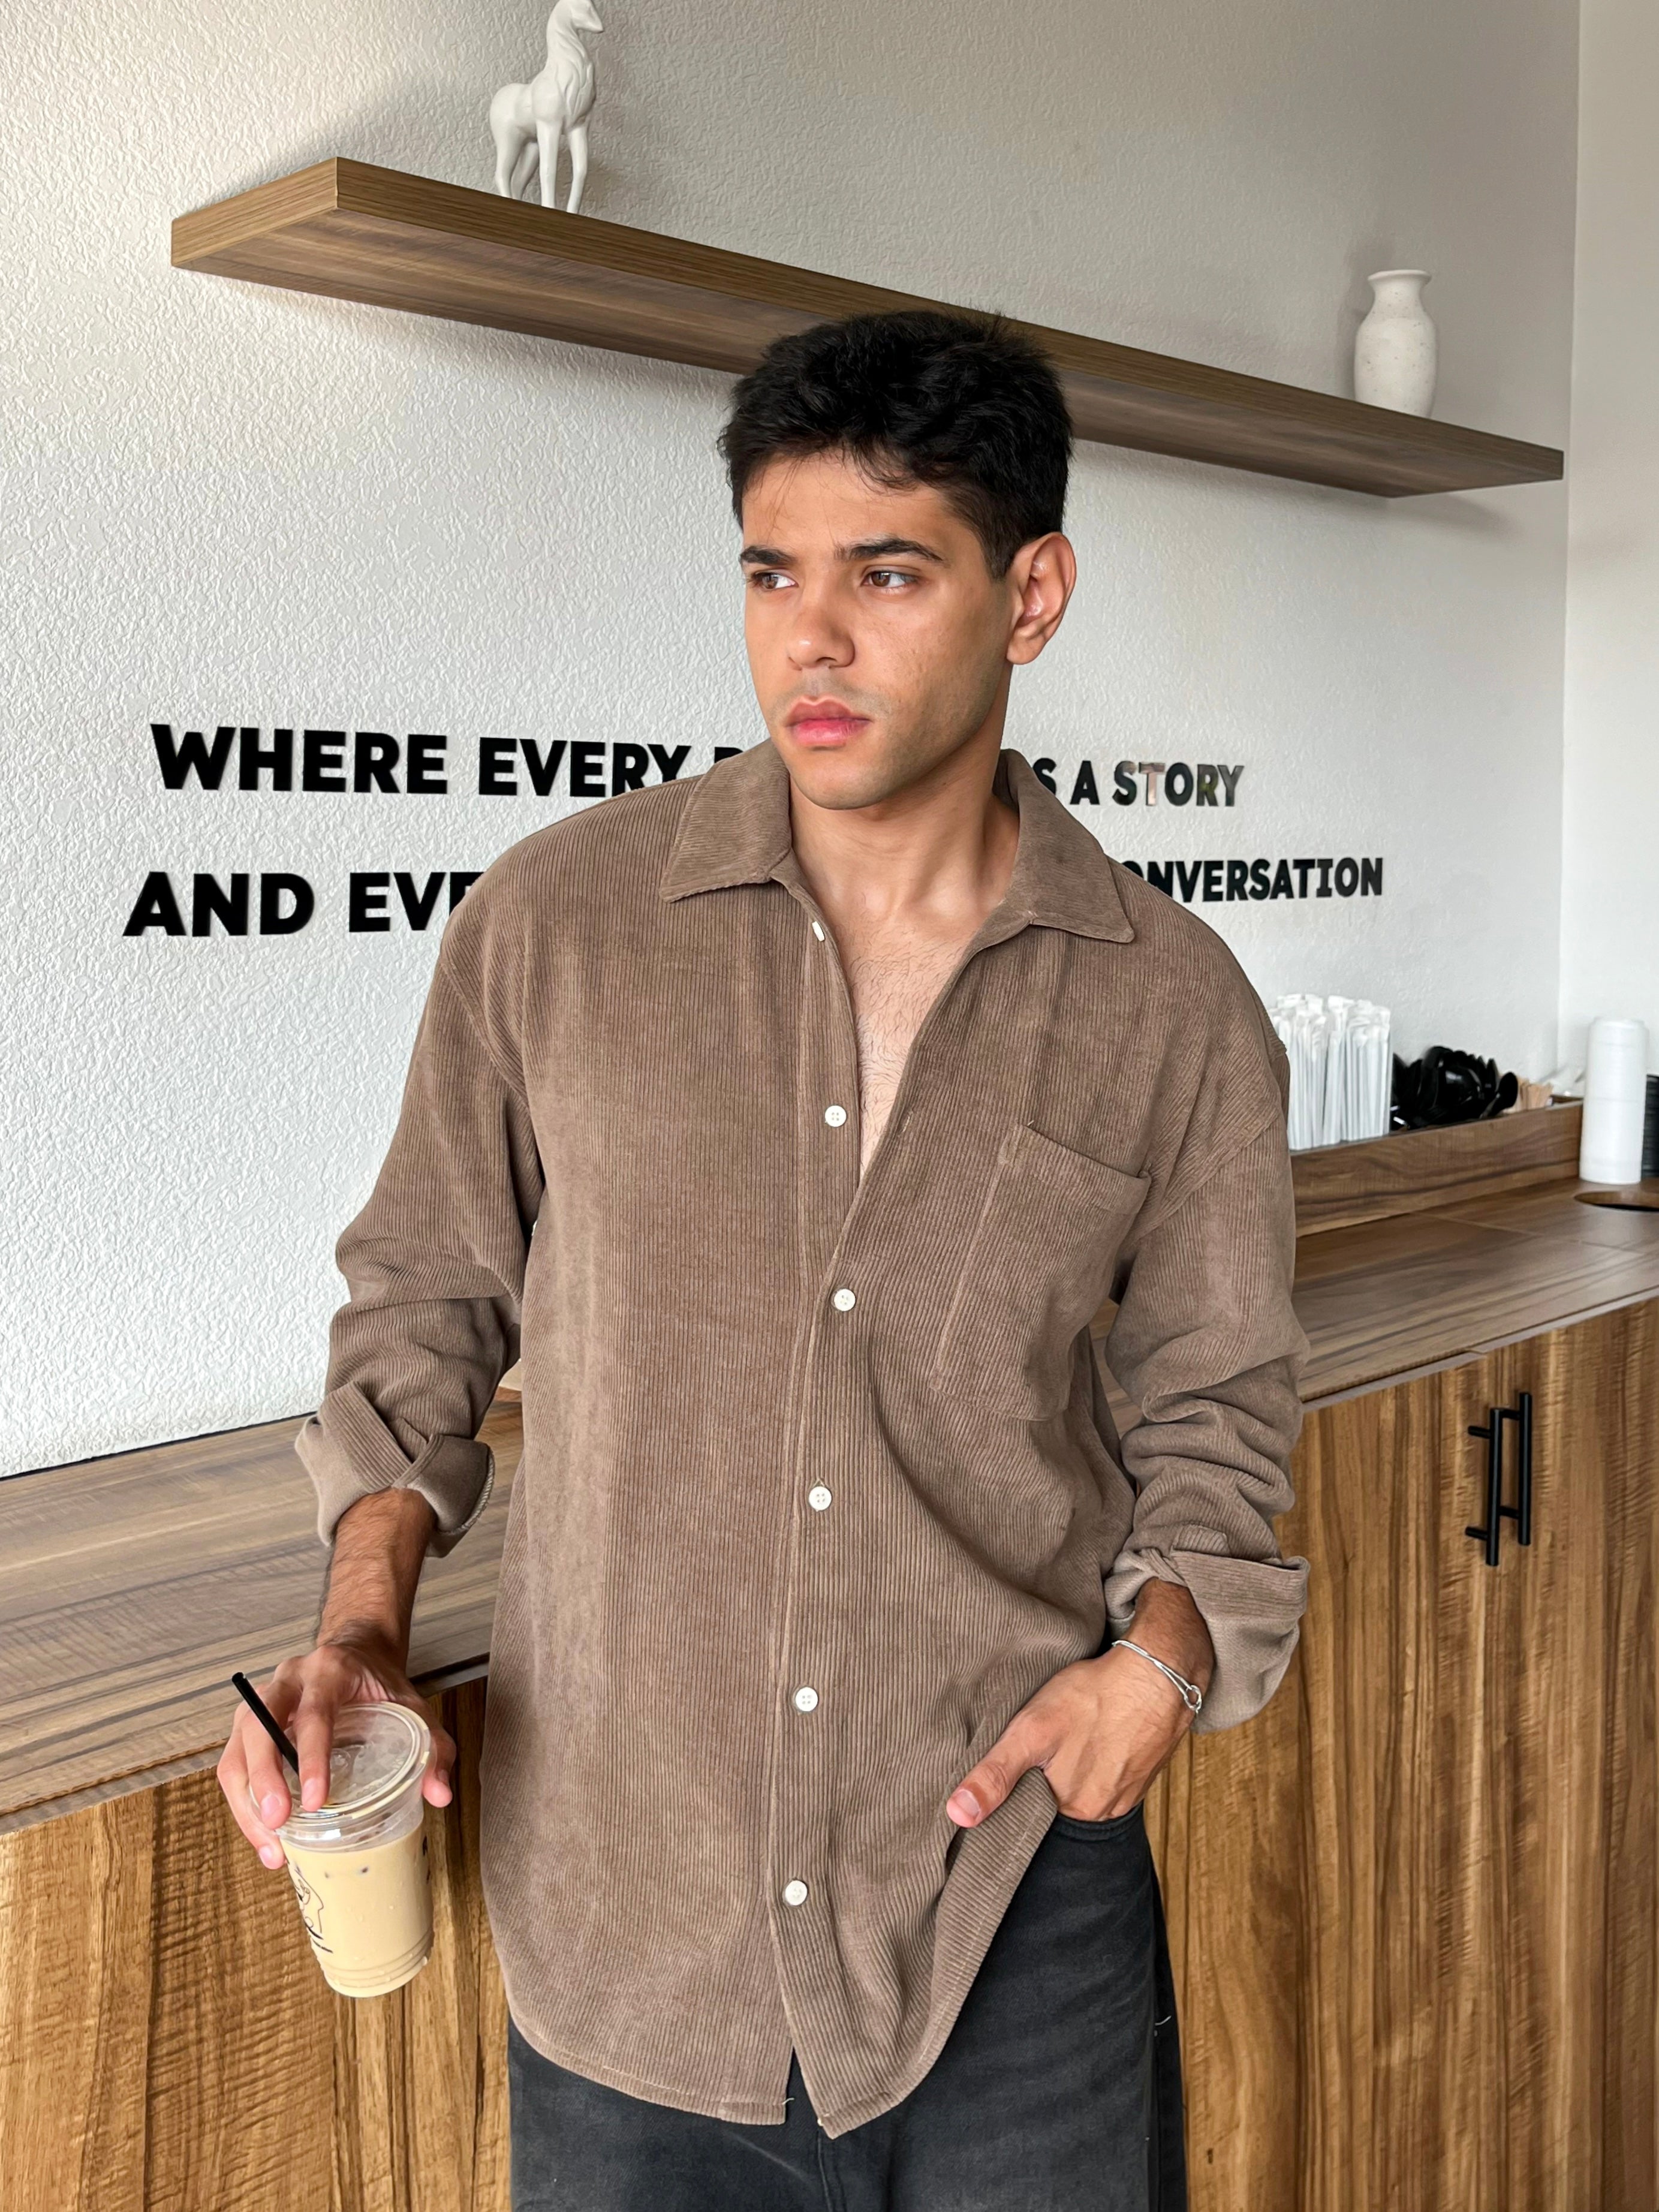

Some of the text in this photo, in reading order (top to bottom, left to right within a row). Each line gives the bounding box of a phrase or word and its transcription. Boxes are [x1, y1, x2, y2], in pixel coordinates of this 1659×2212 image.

[150, 724, 447, 794] WHERE
[478, 737, 691, 797] EVERY
[1070, 760, 1100, 805] A
[1112, 760, 1244, 806] STORY
[122, 872, 314, 937] AND
[1121, 857, 1383, 902] NVERSATION
